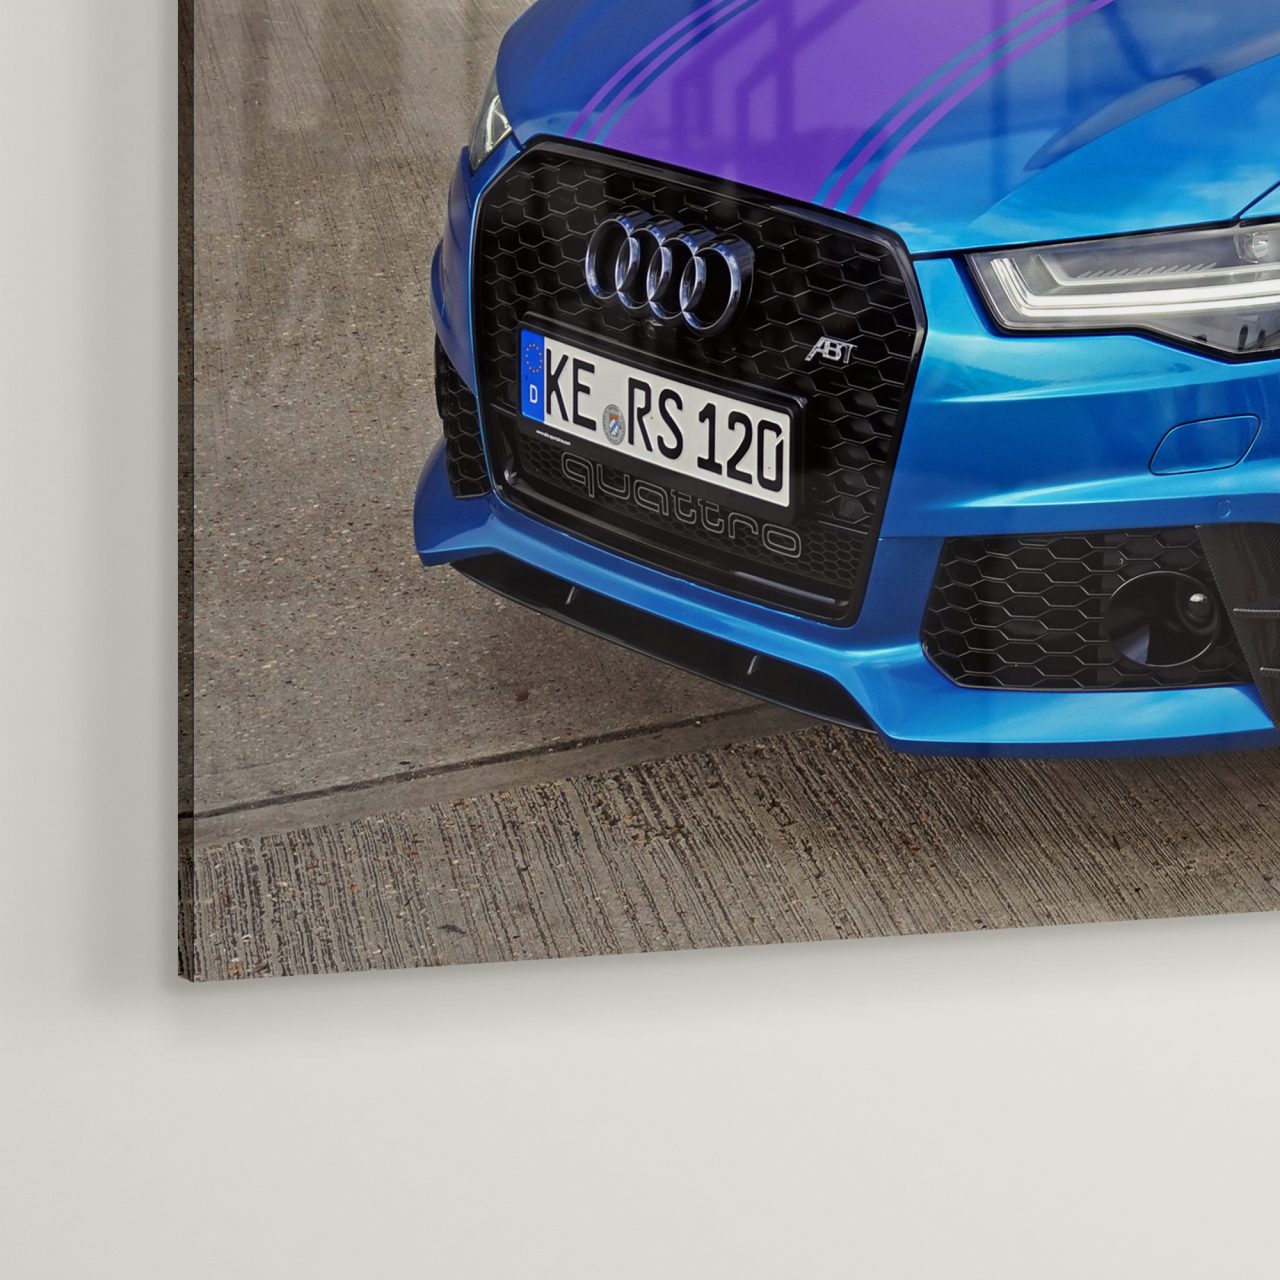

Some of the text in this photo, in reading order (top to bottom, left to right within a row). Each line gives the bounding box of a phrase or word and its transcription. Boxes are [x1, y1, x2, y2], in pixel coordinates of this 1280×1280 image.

[804, 336, 858, 364] ABT
[529, 384, 538, 404] D
[545, 348, 784, 493] KE RS 120
[561, 452, 801, 558] quattro
